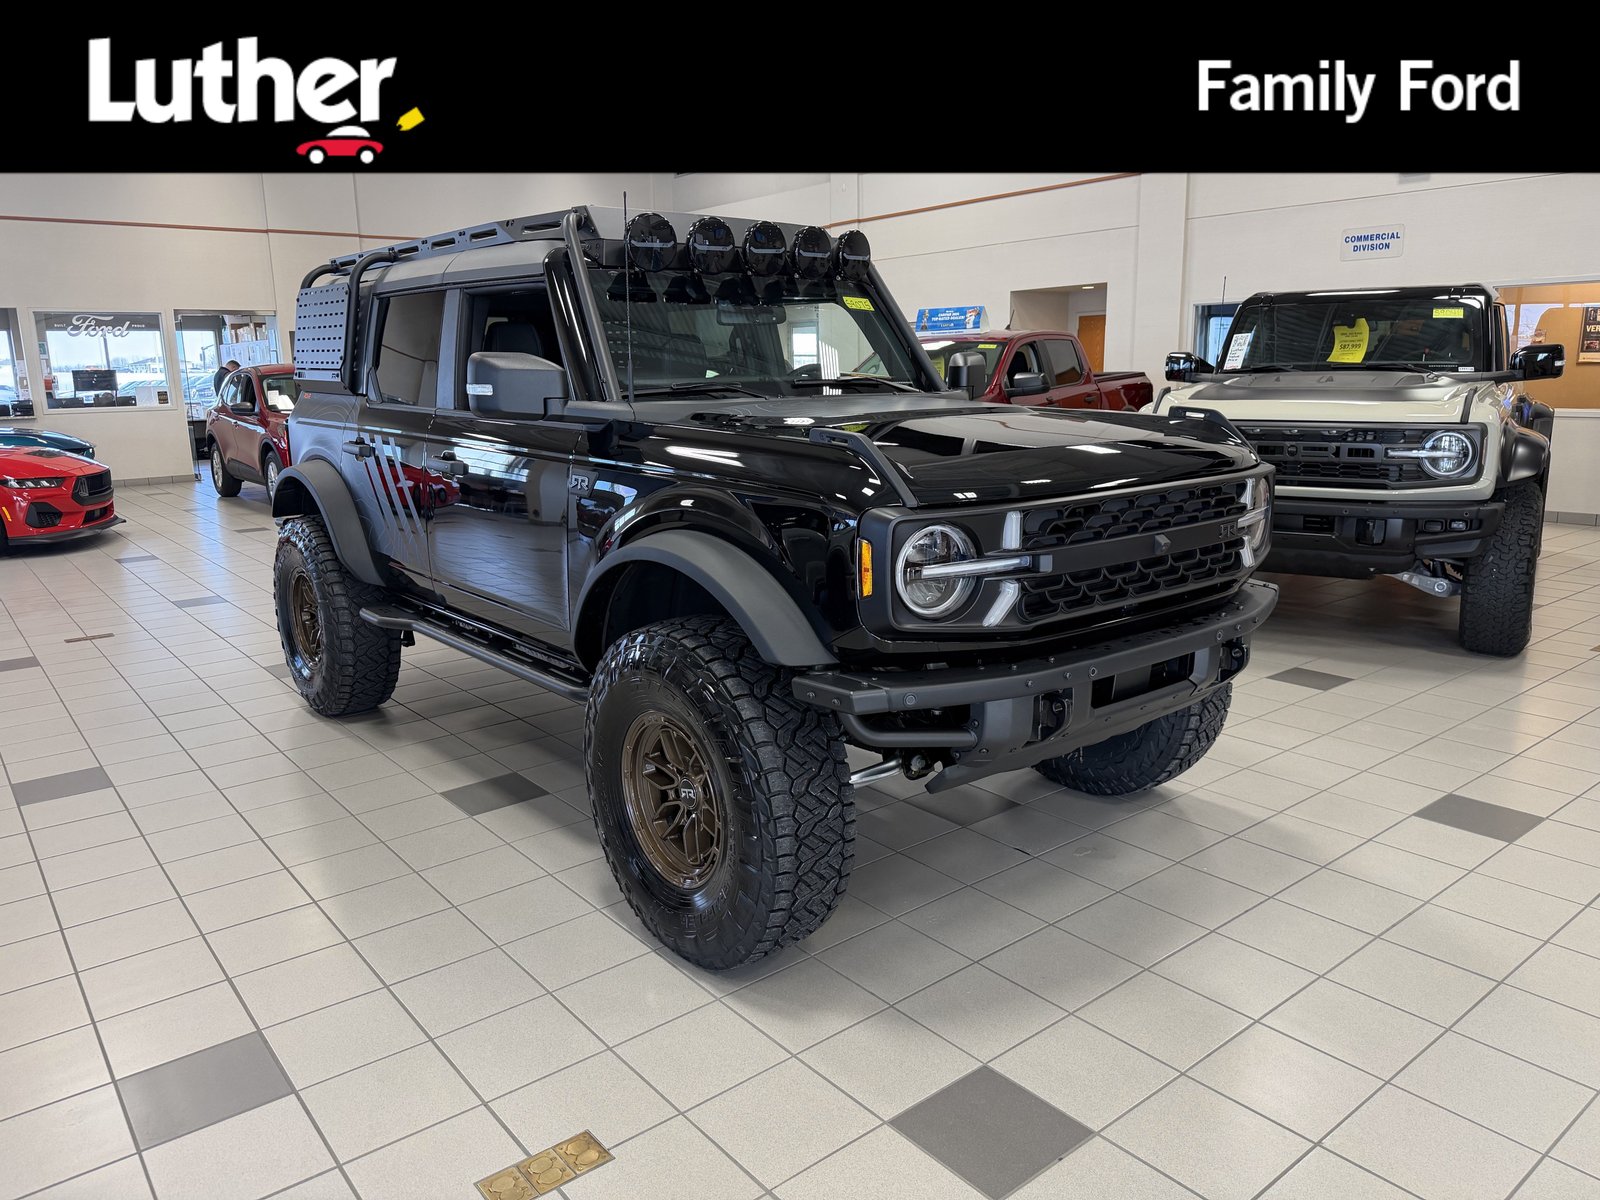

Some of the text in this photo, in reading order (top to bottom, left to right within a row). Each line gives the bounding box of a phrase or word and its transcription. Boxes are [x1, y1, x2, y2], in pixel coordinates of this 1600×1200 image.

[1344, 231, 1401, 244] COMMERCIAL
[1352, 242, 1391, 252] DIVISION
[67, 314, 130, 337] Ford
[1339, 343, 1362, 351] $87,999
